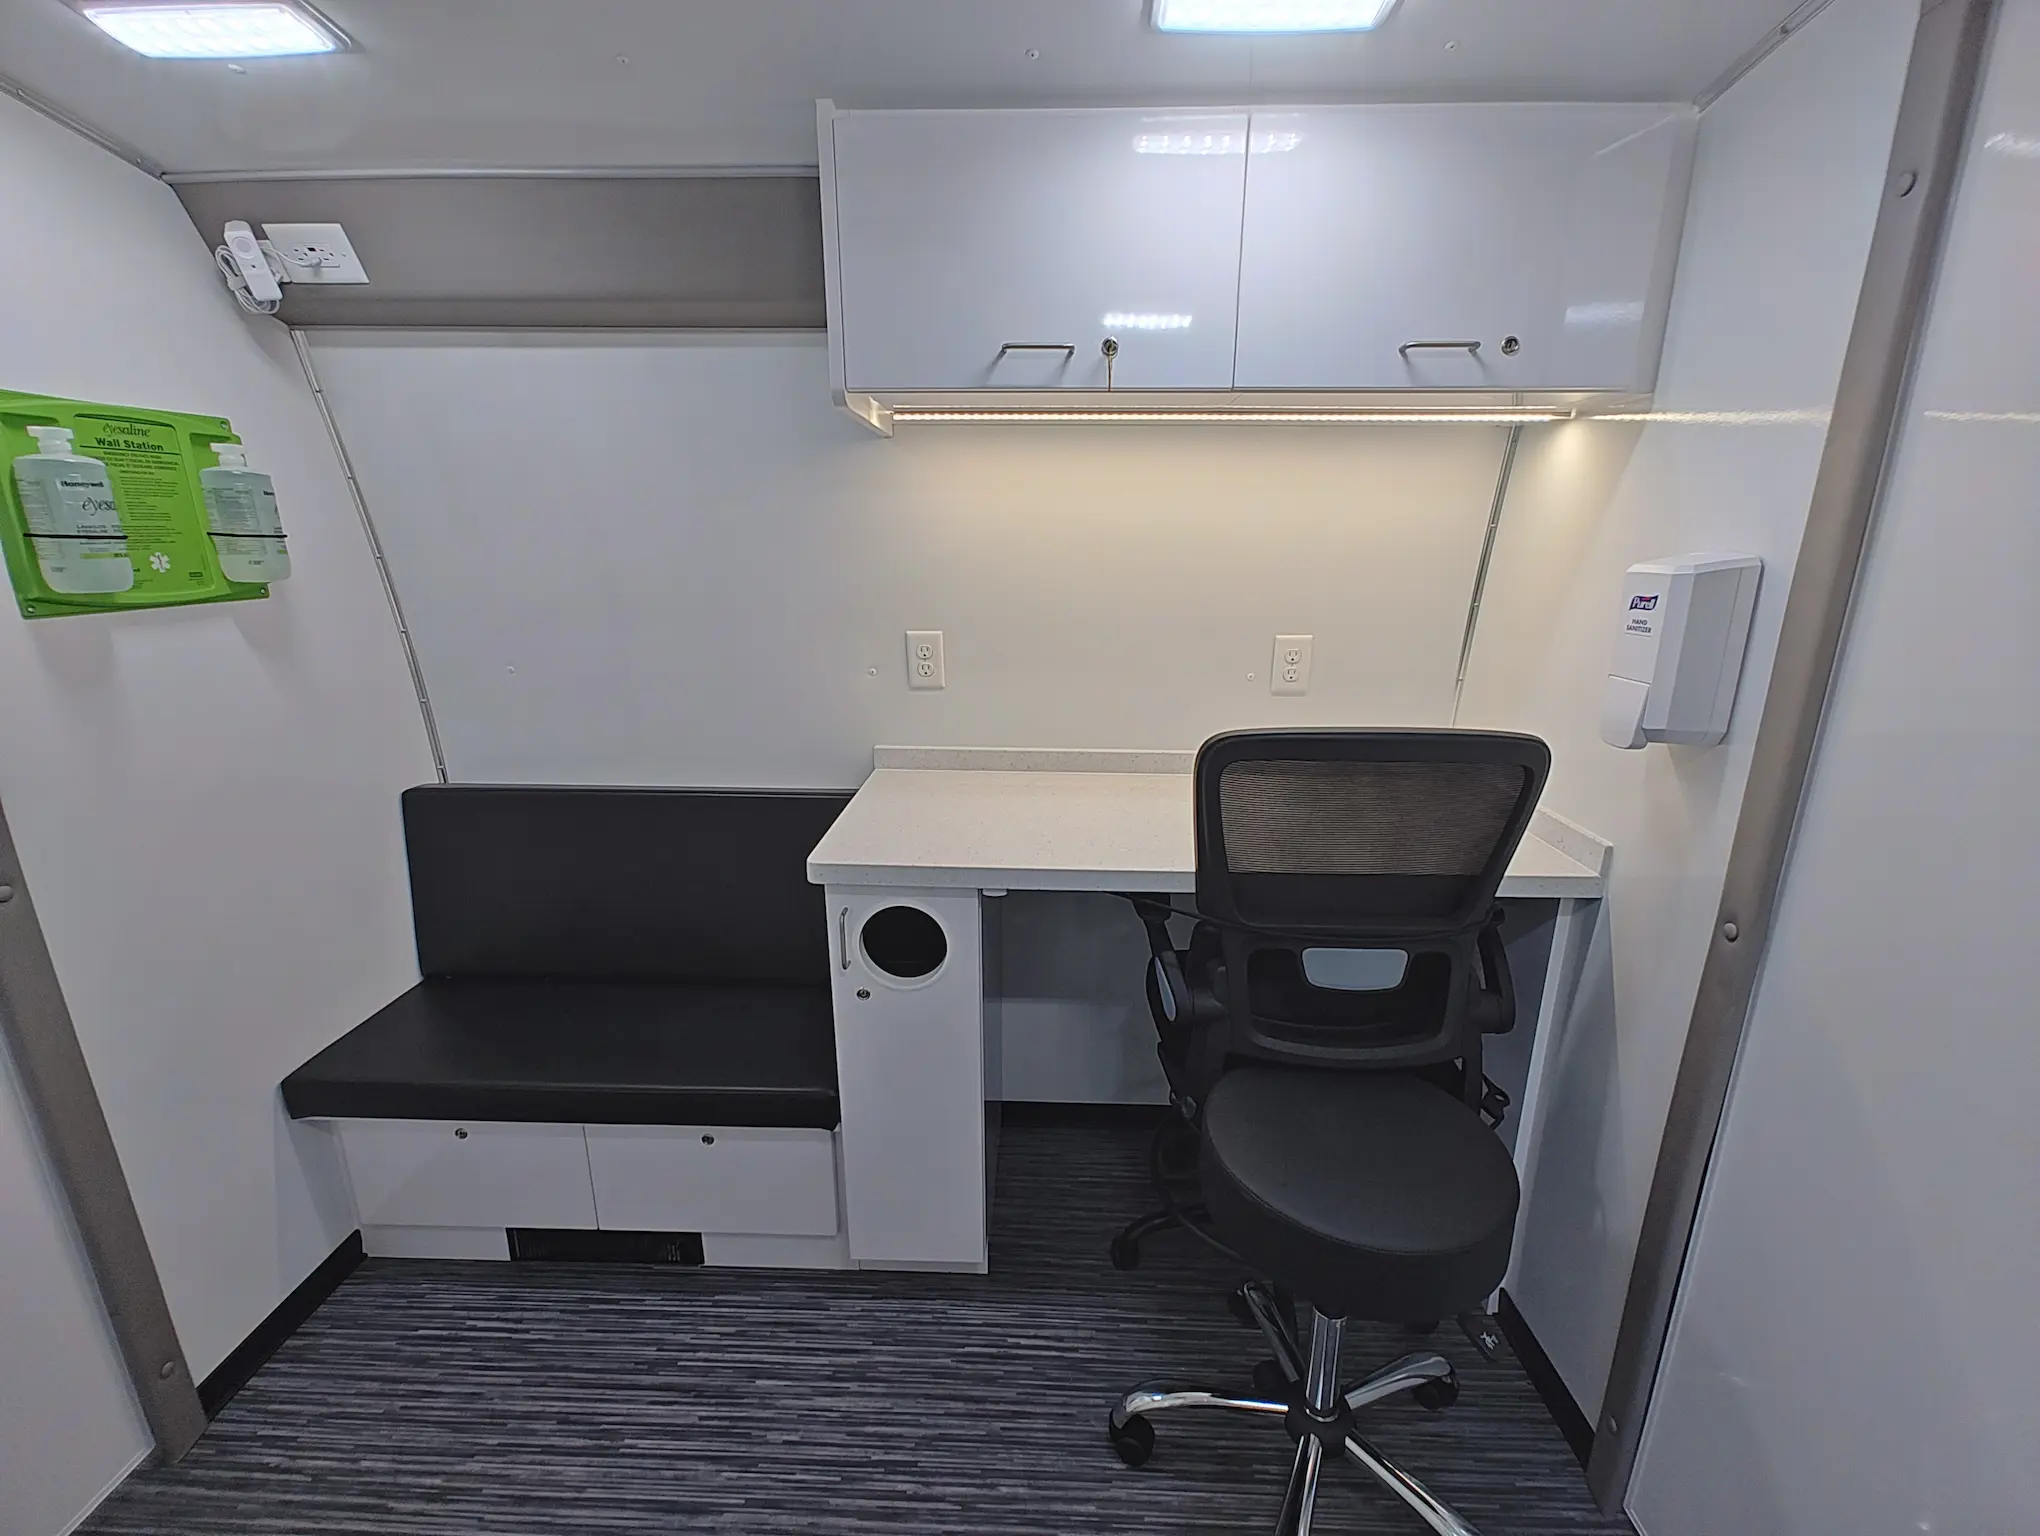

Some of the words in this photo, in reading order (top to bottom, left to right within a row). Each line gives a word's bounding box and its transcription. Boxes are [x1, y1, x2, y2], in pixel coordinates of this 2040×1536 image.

[94, 436, 121, 448] Wall
[123, 439, 164, 451] Station
[60, 480, 105, 489] Honeywell
[1632, 597, 1656, 609] Purell
[1626, 624, 1652, 633] SANITIZER
